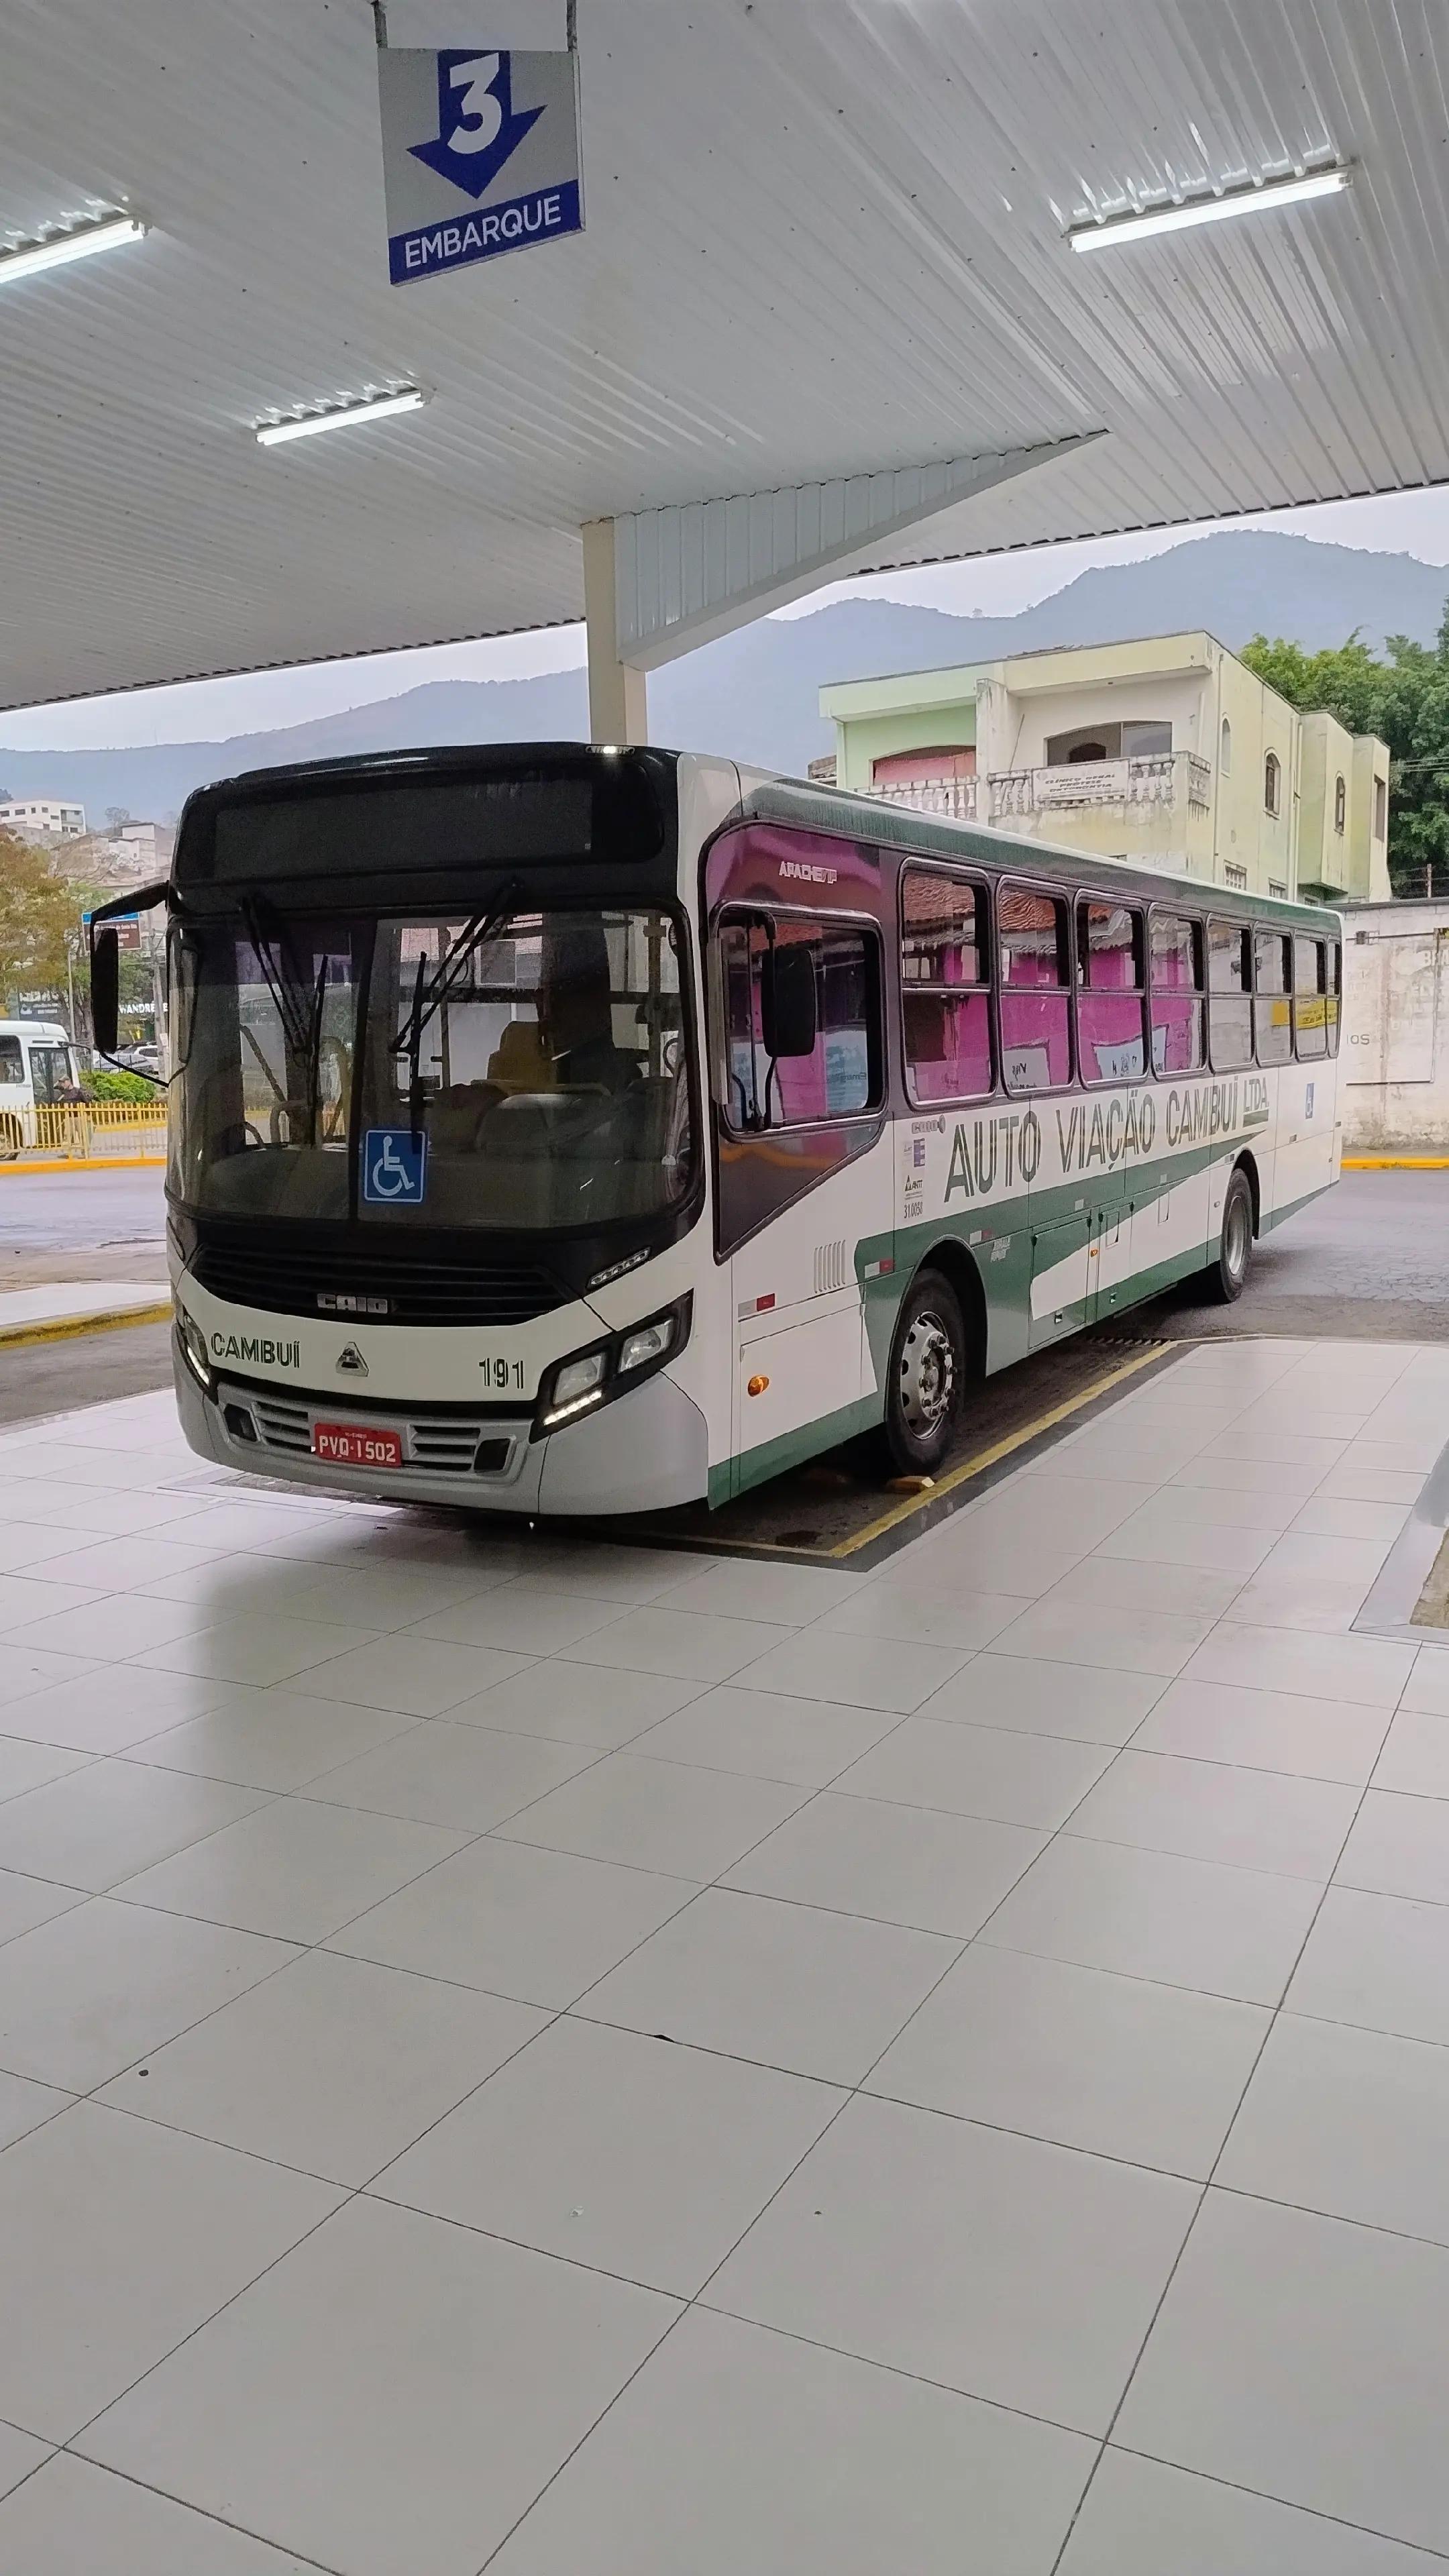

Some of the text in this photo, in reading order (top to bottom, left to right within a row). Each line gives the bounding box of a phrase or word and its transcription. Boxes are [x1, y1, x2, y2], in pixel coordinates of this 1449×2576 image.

[447, 52, 502, 154] 3
[405, 195, 561, 268] EMBARQUE
[944, 1110, 1041, 1203] AUTO
[1055, 1089, 1156, 1171] VIAÇÃO
[1166, 1075, 1238, 1147] CAMBUÍ
[317, 1293, 388, 1314] CAIO
[211, 1332, 301, 1368] CAMBUÍ
[478, 1358, 524, 1389] 191
